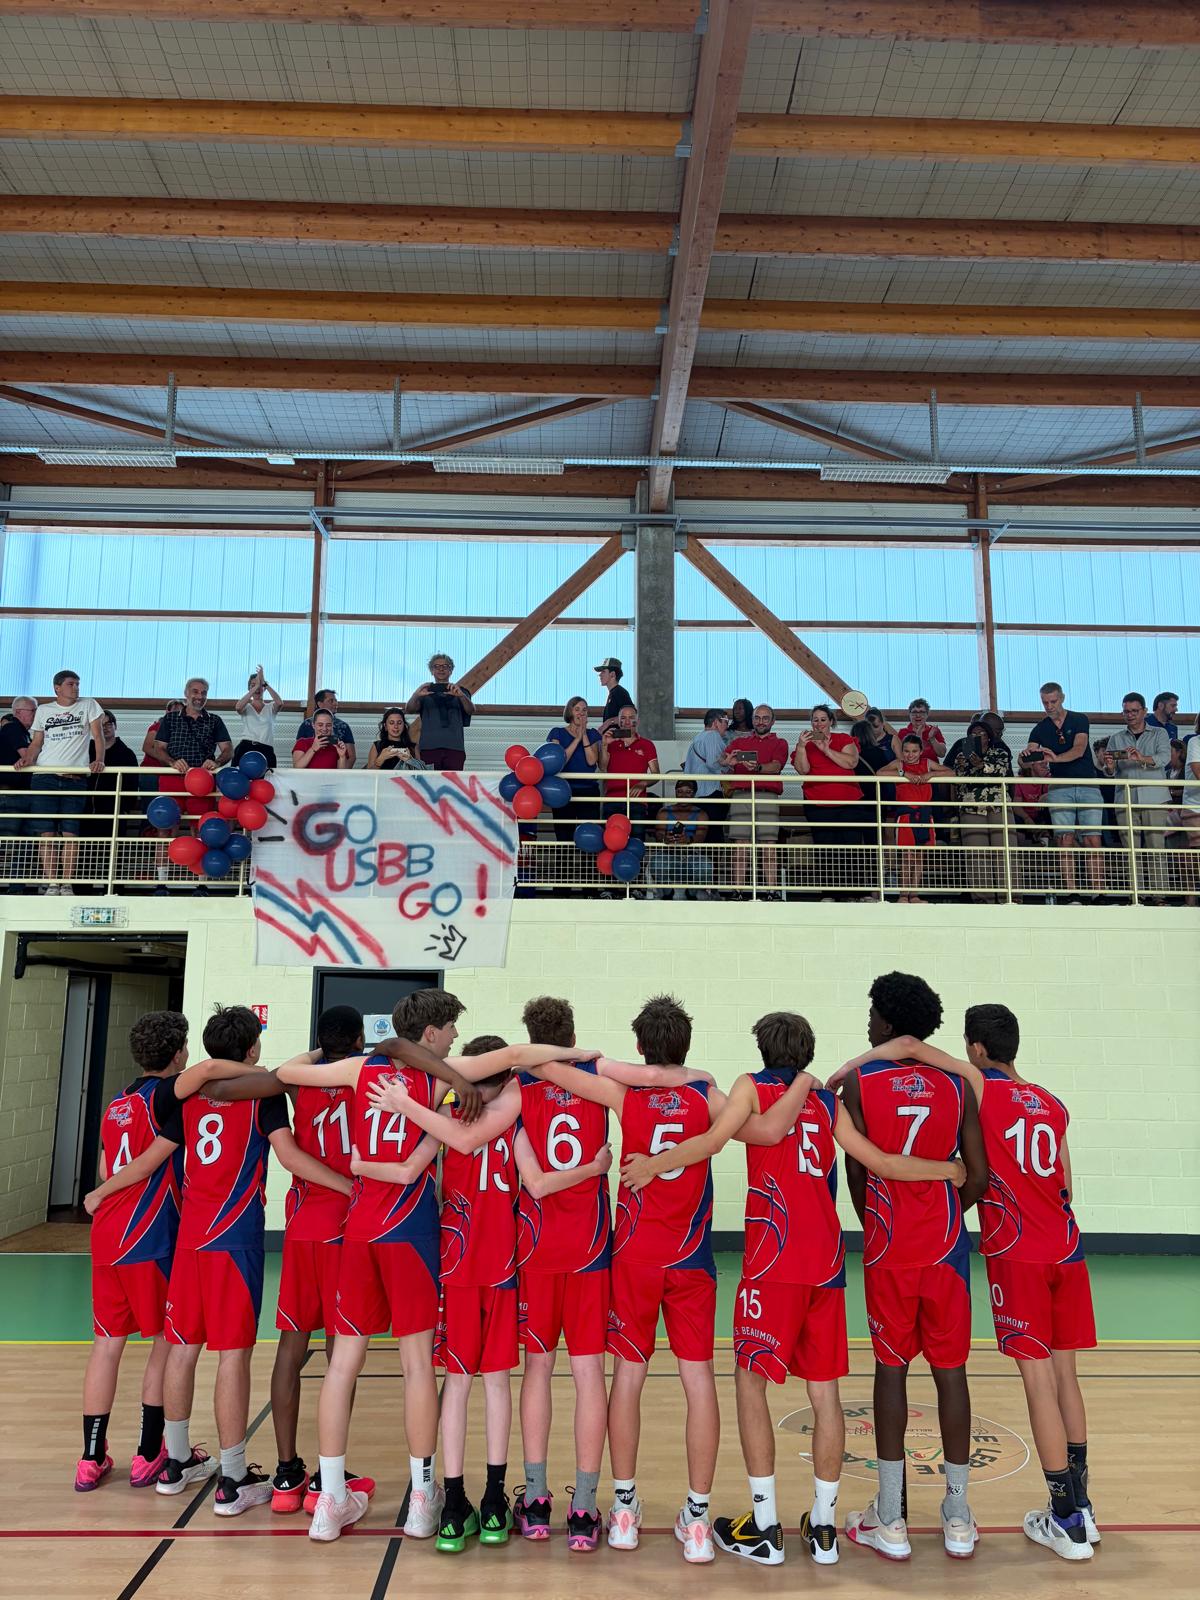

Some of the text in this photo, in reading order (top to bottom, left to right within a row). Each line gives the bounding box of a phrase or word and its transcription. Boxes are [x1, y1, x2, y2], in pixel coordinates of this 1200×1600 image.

[292, 801, 377, 856] GO
[325, 842, 435, 892] USBB
[398, 881, 462, 920] GO
[112, 1131, 134, 1175] 4
[195, 1112, 224, 1166] 8
[312, 1100, 352, 1158] 11
[363, 1106, 408, 1156] 14
[547, 1112, 583, 1172] 6
[649, 1123, 684, 1181] 5
[895, 1105, 931, 1157] 7
[1003, 1117, 1058, 1178] 10
[473, 1137, 510, 1192] 13
[739, 1287, 762, 1320] 15
[993, 1314, 1030, 1330] EAUMONT
[741, 1326, 781, 1350] BEAUMONT
